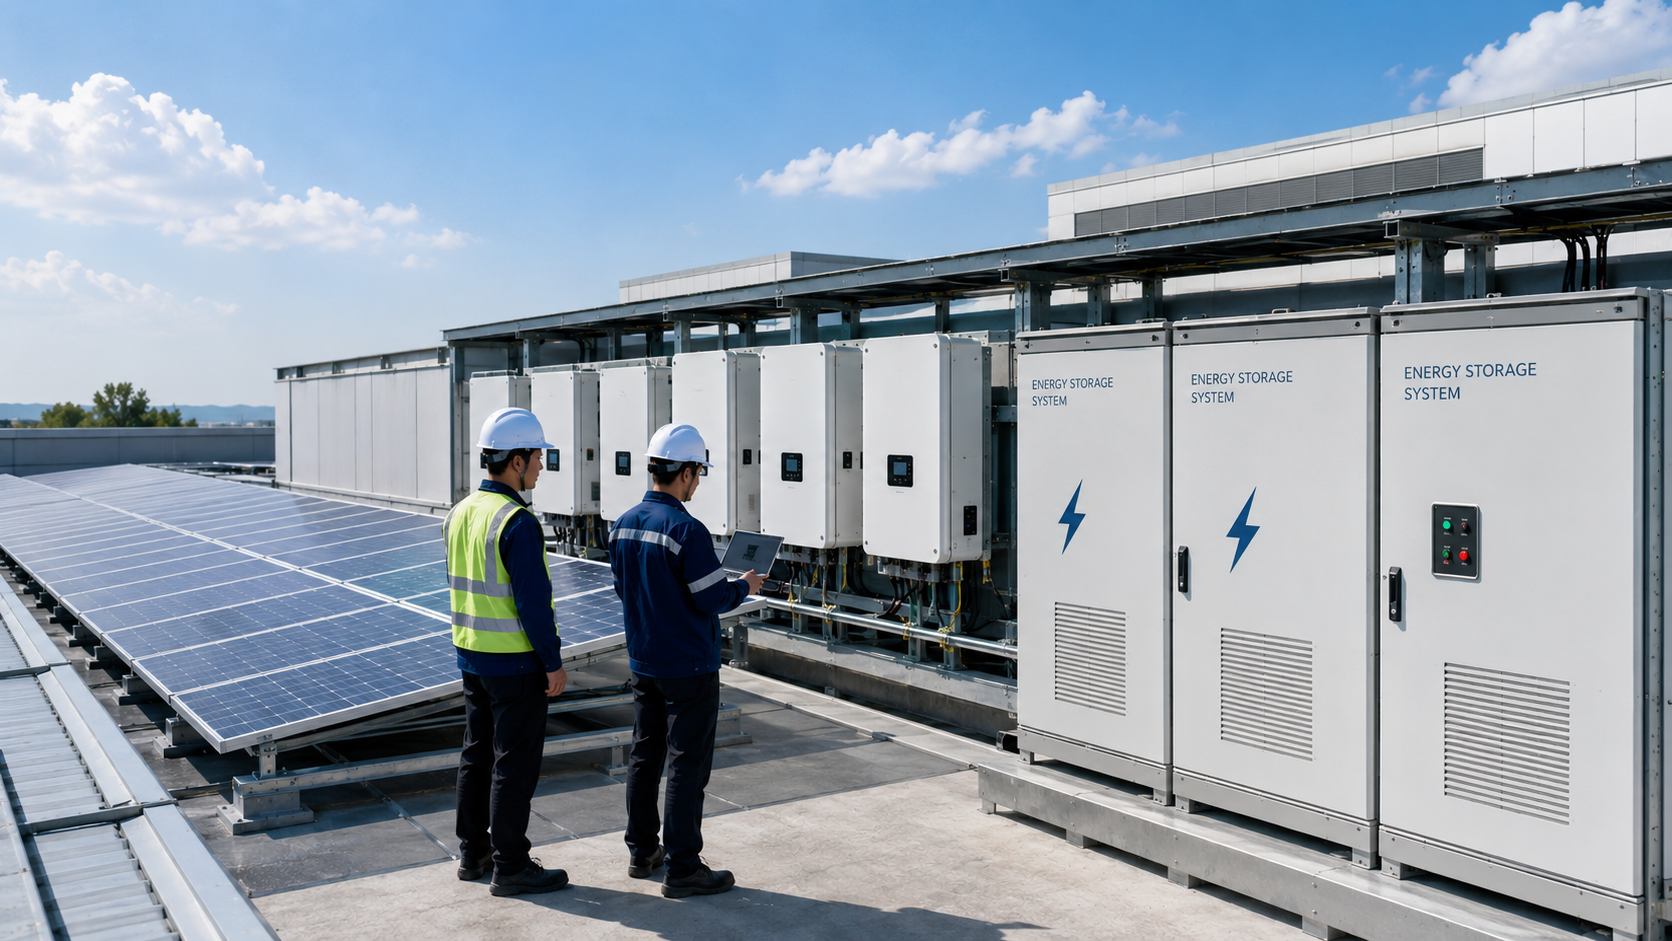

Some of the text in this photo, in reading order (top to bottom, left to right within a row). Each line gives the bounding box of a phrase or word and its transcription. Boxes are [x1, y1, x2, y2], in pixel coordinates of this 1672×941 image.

[1191, 371, 1294, 386] ENERGY STORAGE
[1404, 363, 1537, 380] ENERGY STORAGE
[1031, 377, 1114, 390] ENERGY STORAGE
[1191, 391, 1235, 404] SYSTEM
[1404, 386, 1461, 401] SYSTEM
[1031, 395, 1068, 407] SYSTEM
